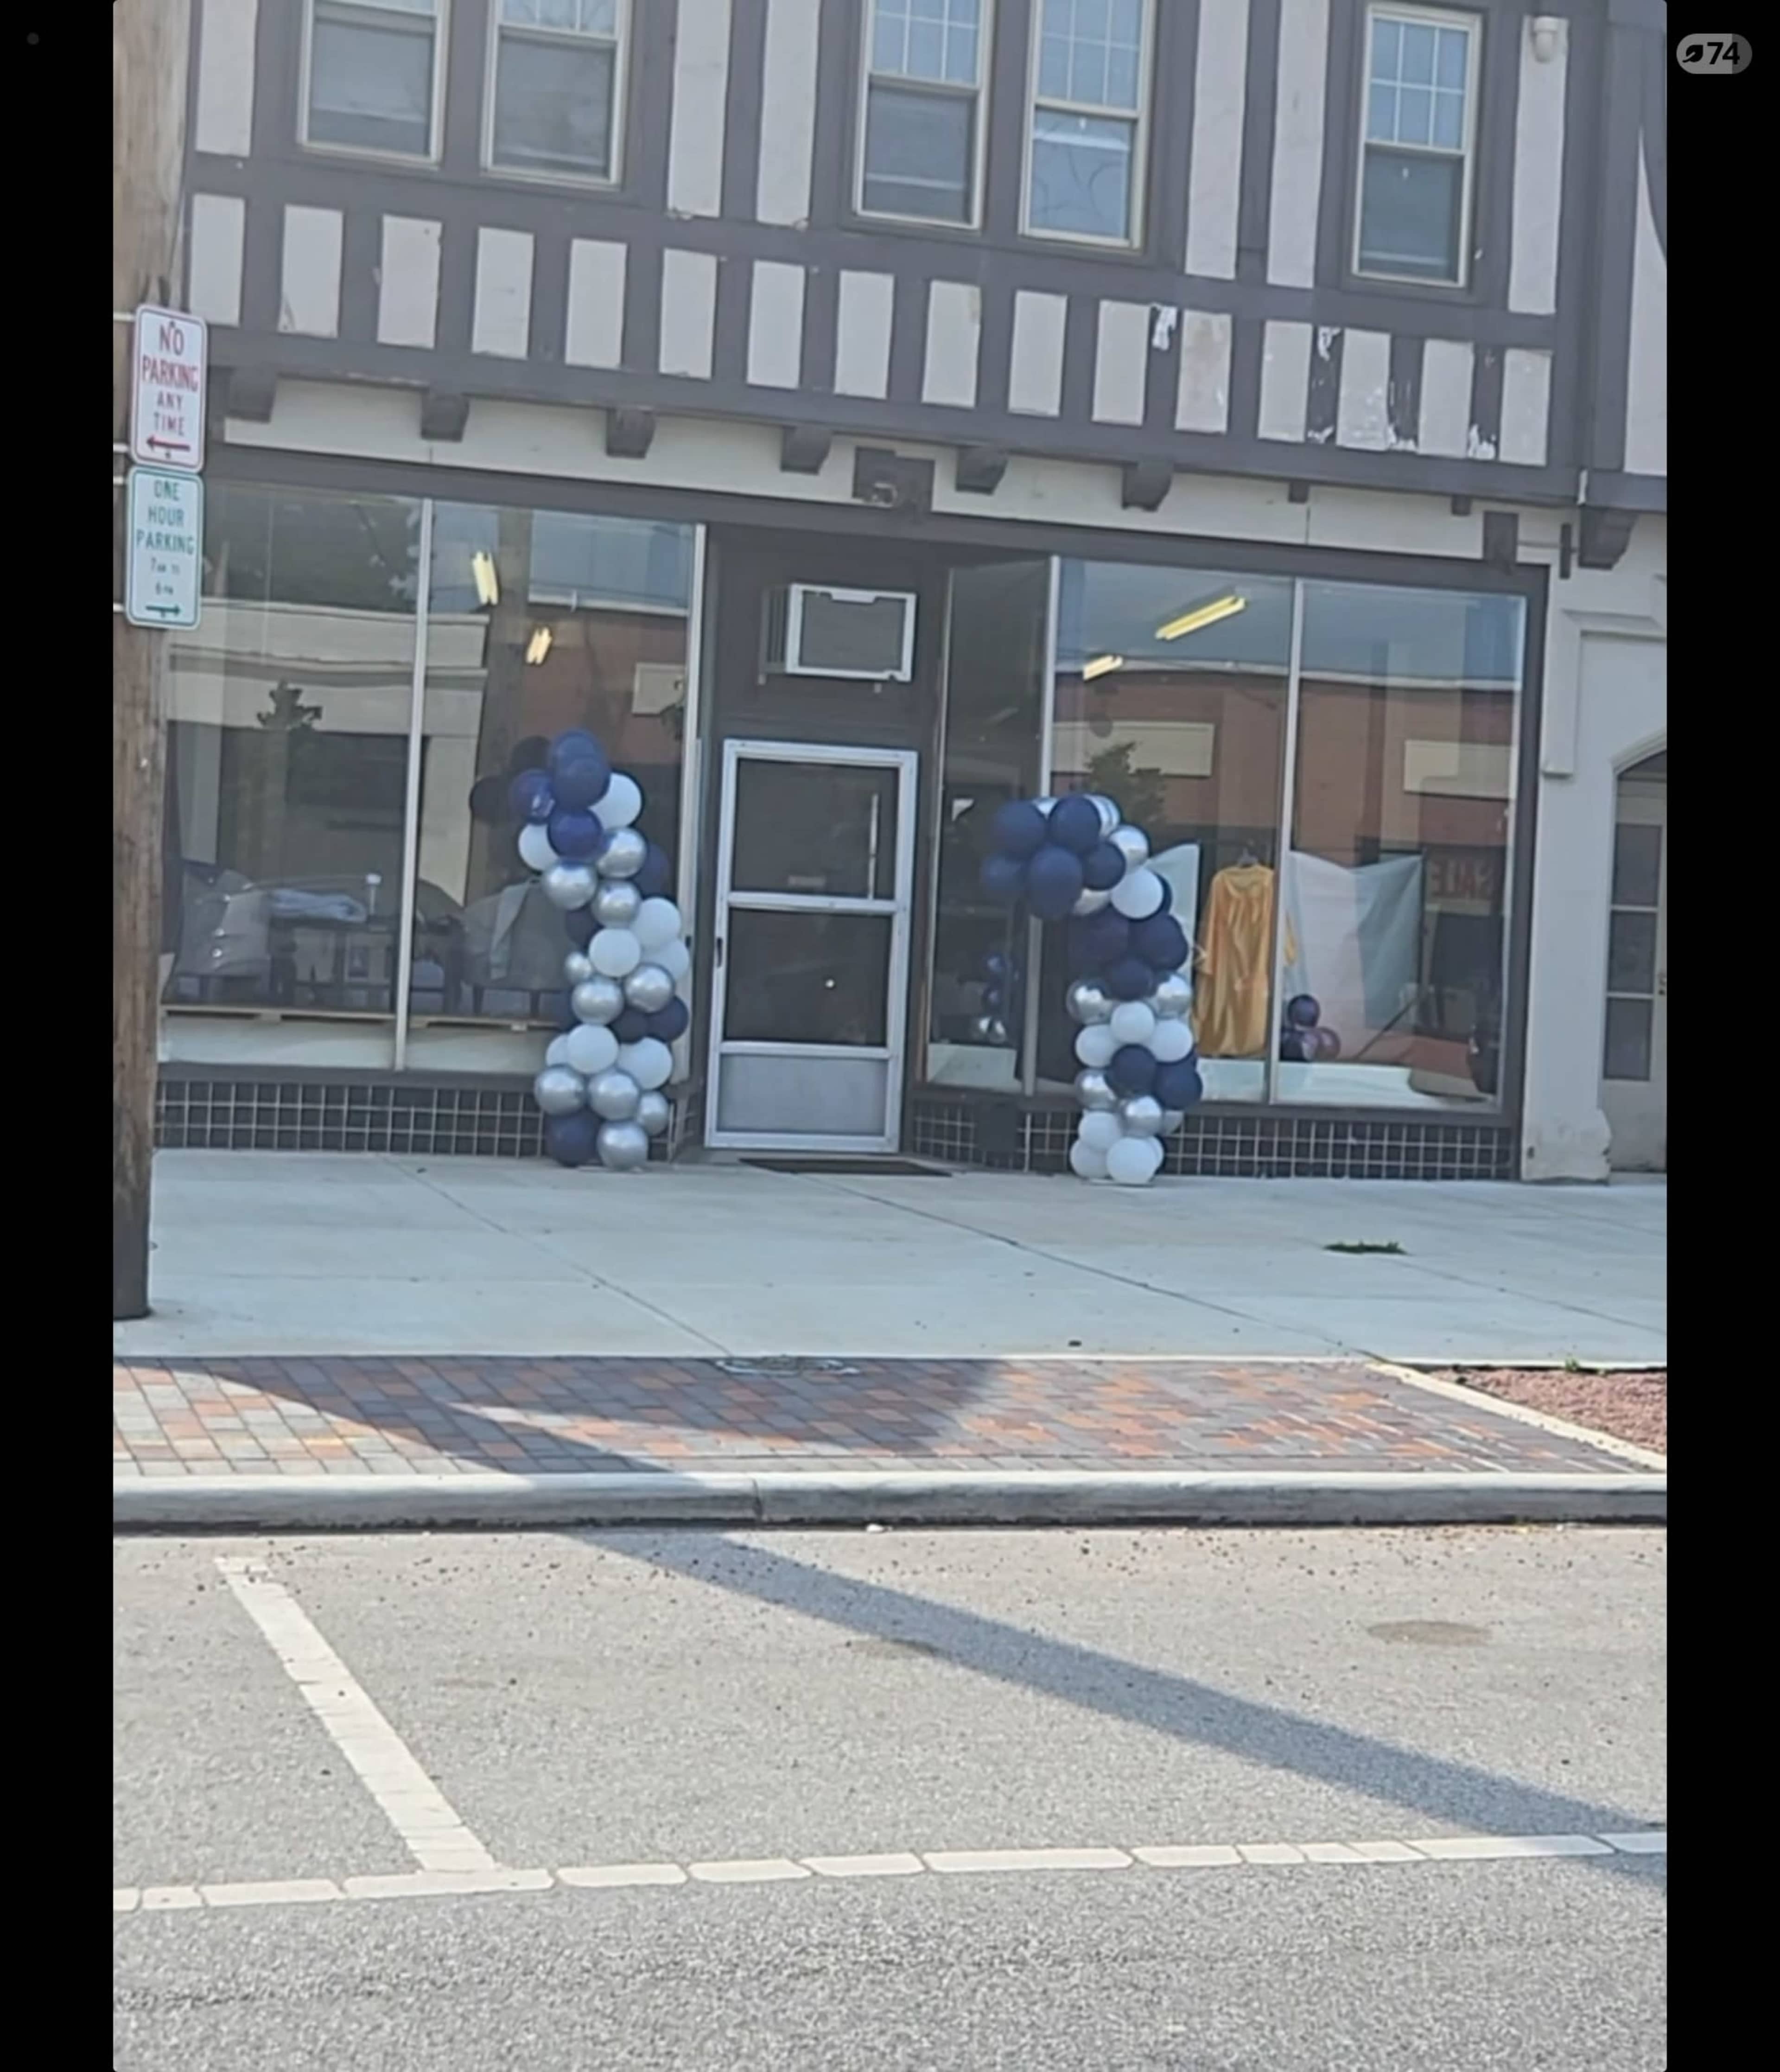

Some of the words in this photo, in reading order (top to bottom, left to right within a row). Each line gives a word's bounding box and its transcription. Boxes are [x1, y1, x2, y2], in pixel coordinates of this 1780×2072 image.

[159, 324, 184, 356] NO
[142, 354, 198, 392] PARKING
[157, 390, 184, 412] ANY
[153, 411, 184, 437] TIME
[154, 479, 180, 501] ONE
[148, 506, 184, 527] HOUR
[136, 529, 194, 556] PARKING
